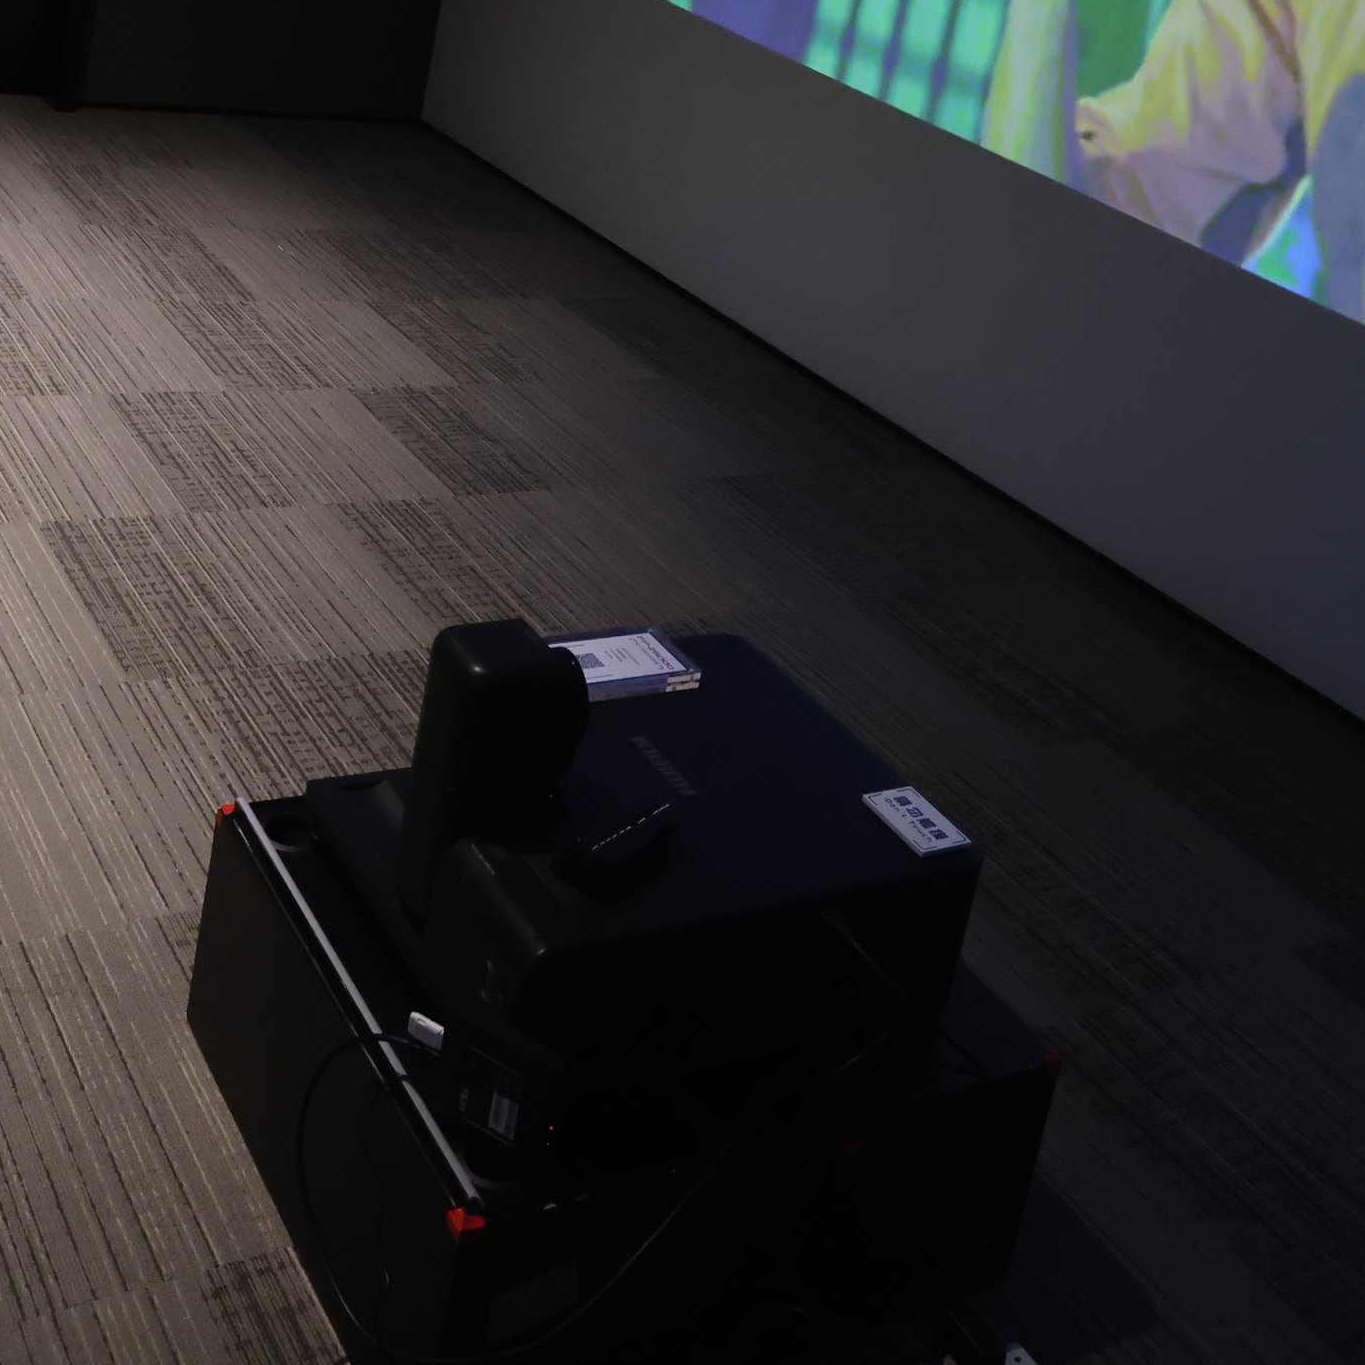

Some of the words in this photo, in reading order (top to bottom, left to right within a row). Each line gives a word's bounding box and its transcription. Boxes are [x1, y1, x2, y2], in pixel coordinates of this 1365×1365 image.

[631, 736, 696, 795] FUJIFILM
[885, 798, 907, 818] Don't
[909, 820, 932, 843] Touch
